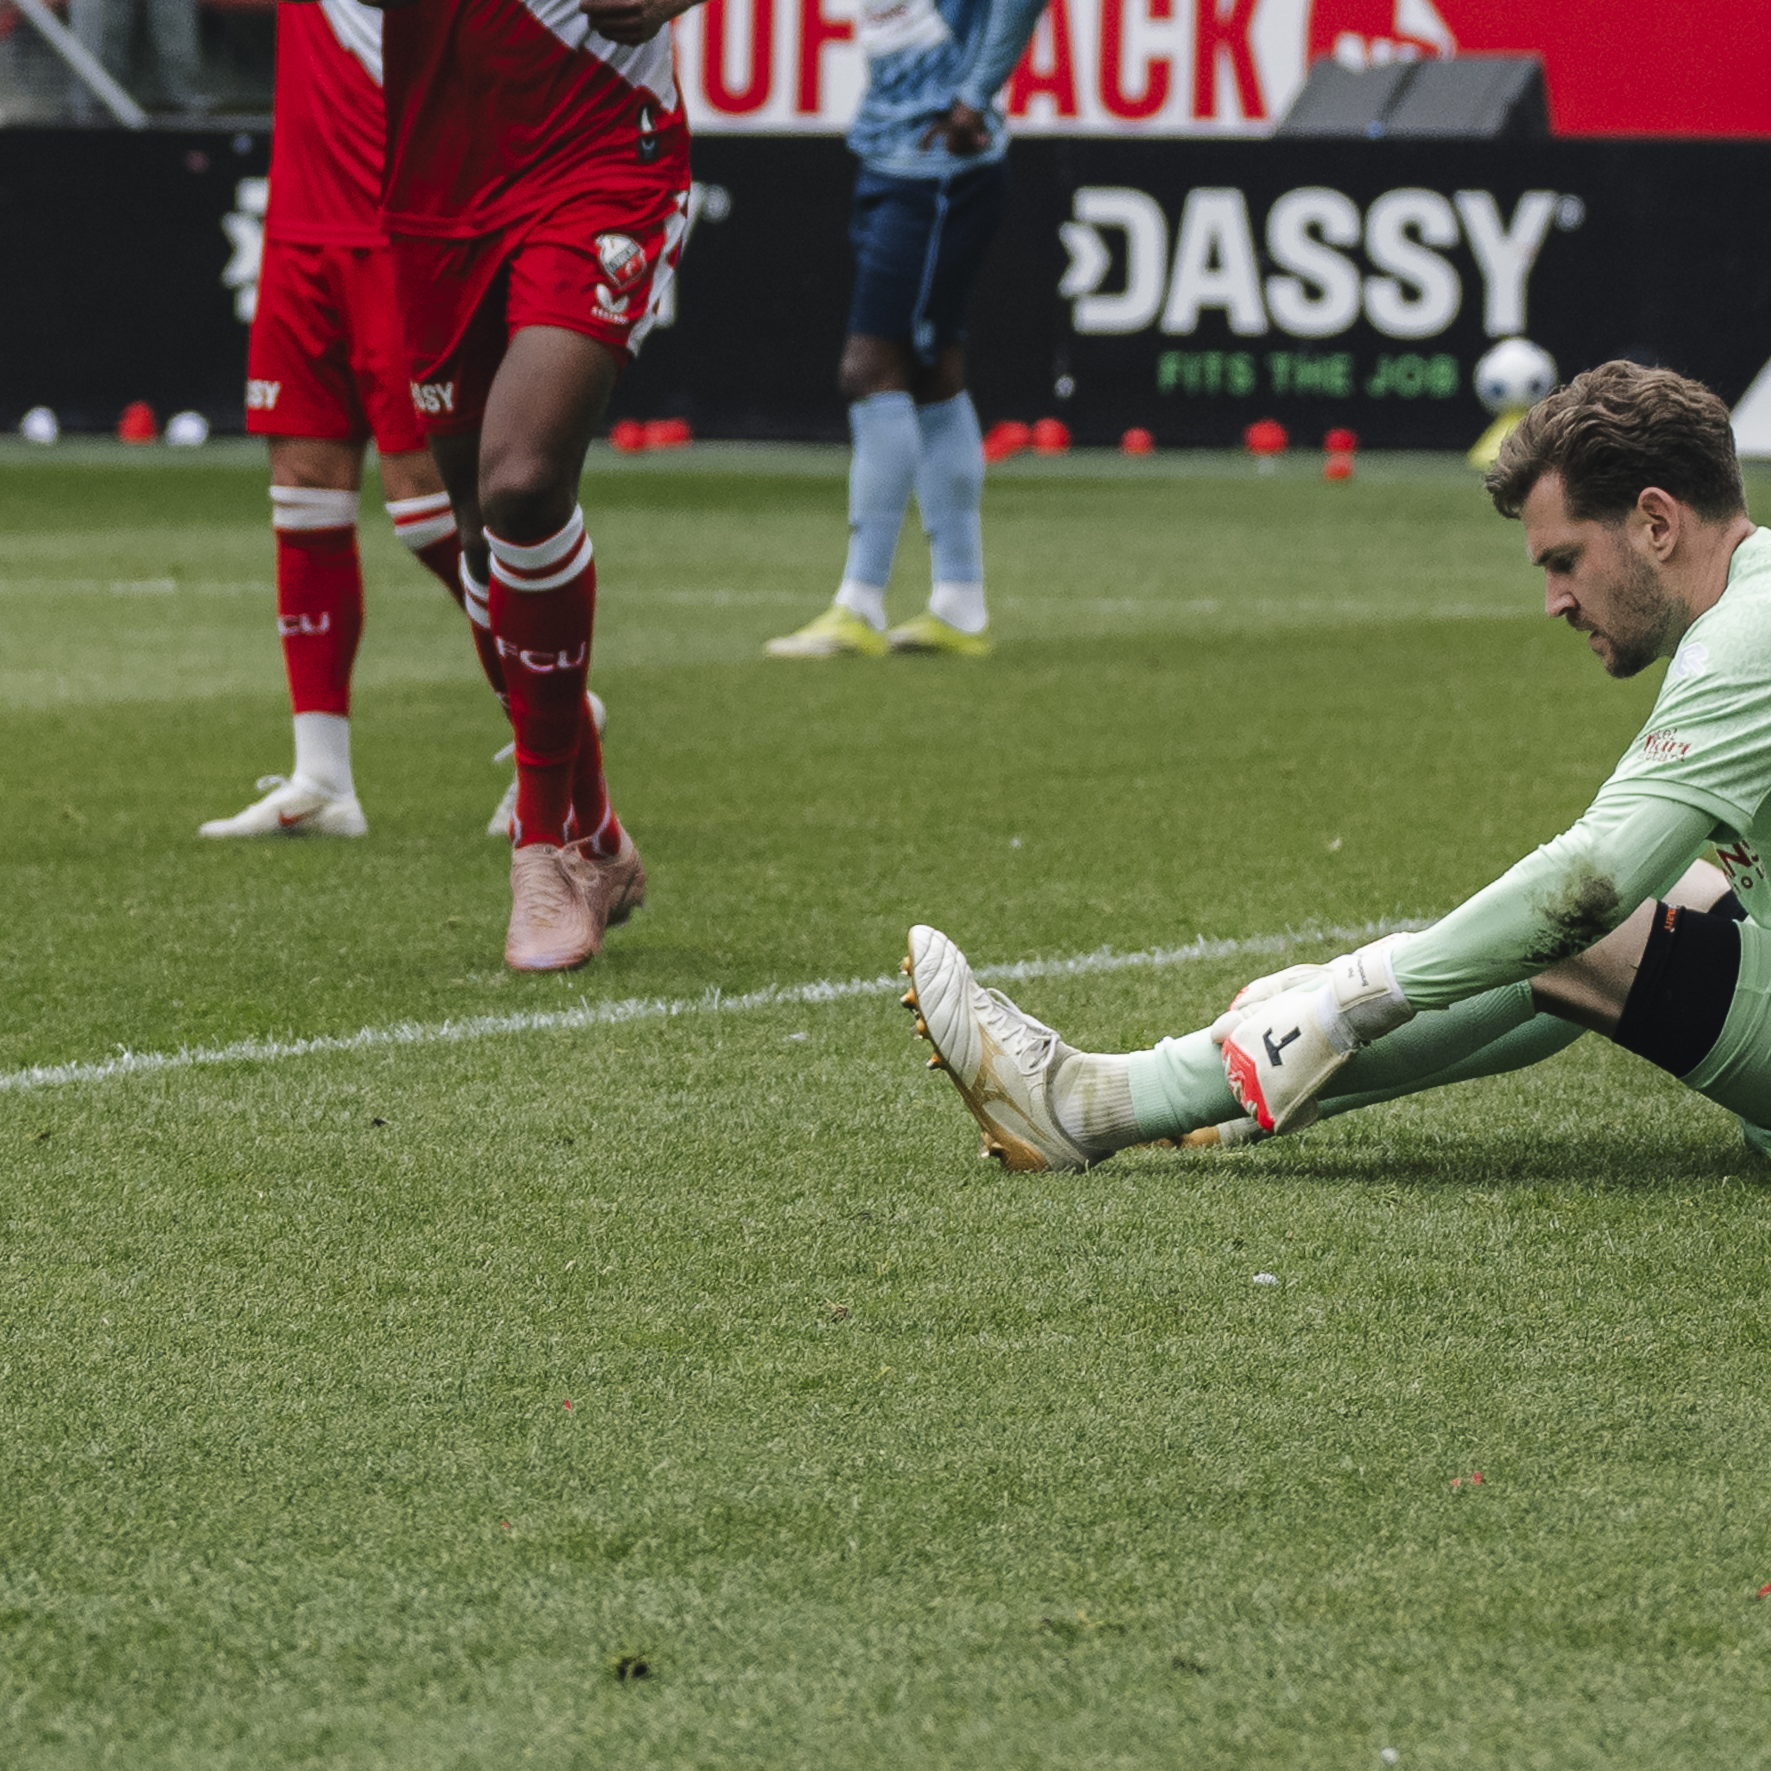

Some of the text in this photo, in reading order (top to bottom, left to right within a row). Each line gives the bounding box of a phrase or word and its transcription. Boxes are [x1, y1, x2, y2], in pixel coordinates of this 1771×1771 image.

[1157, 350, 1459, 398] FITS THE JOB
[492, 635, 587, 673] FCU
